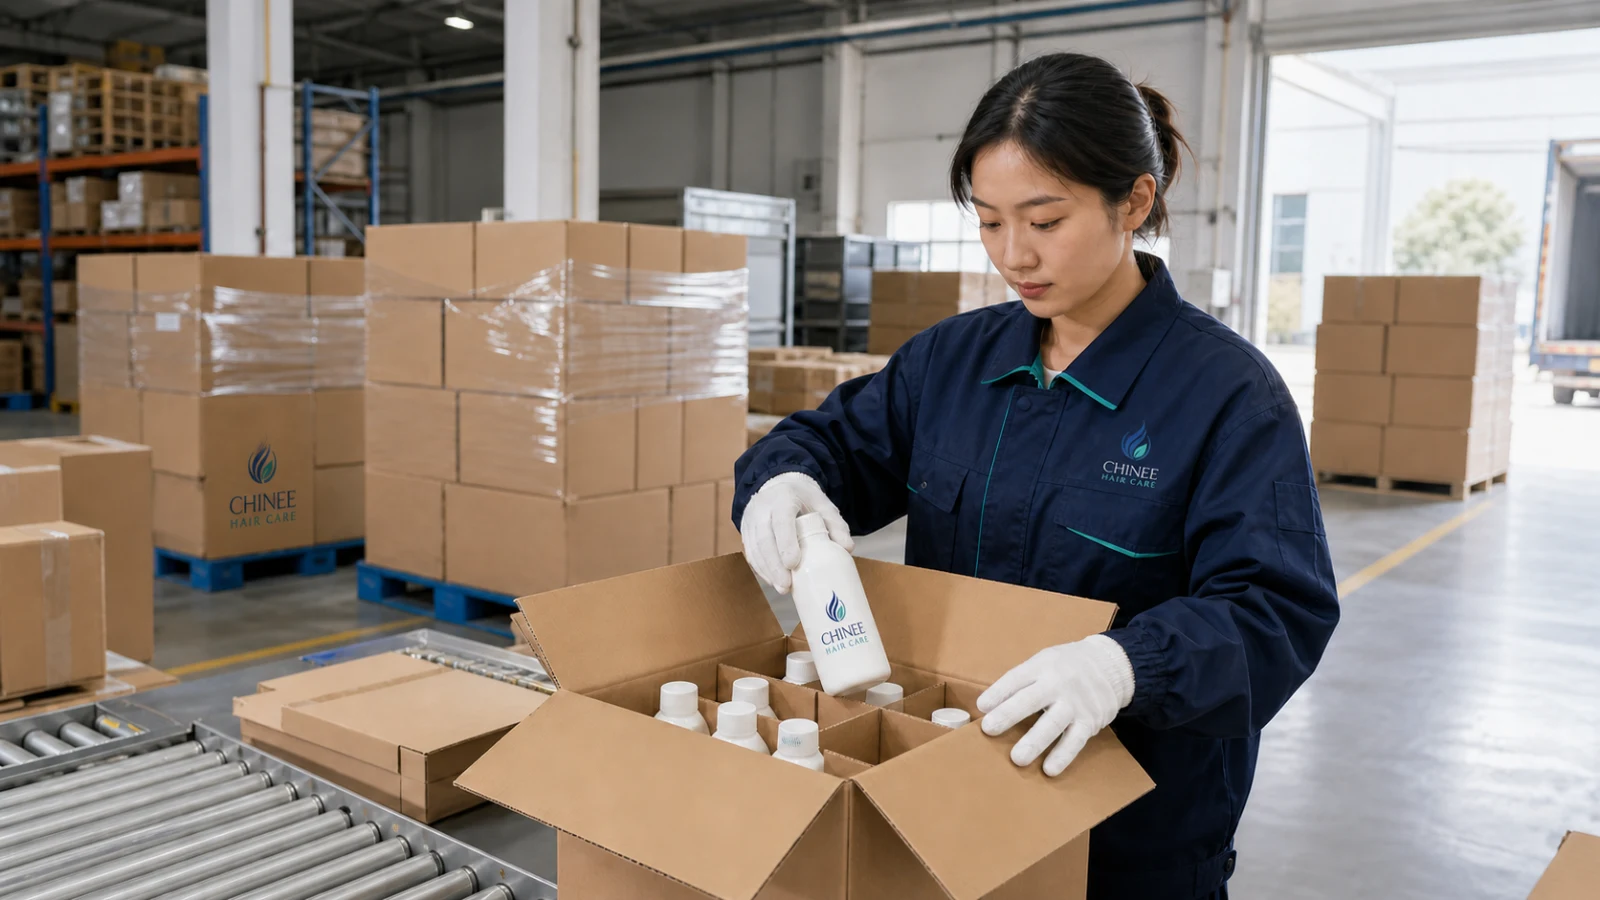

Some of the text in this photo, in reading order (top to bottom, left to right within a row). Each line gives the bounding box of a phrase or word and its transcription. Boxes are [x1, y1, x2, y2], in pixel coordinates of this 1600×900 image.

[1103, 460, 1159, 480] CHINEE
[1101, 473, 1156, 489] HAIR CARE
[229, 490, 296, 515] CHINEE
[230, 511, 296, 529] HAIR CARE
[821, 621, 866, 645] CHINEE
[825, 635, 869, 655] HAIR CARE
